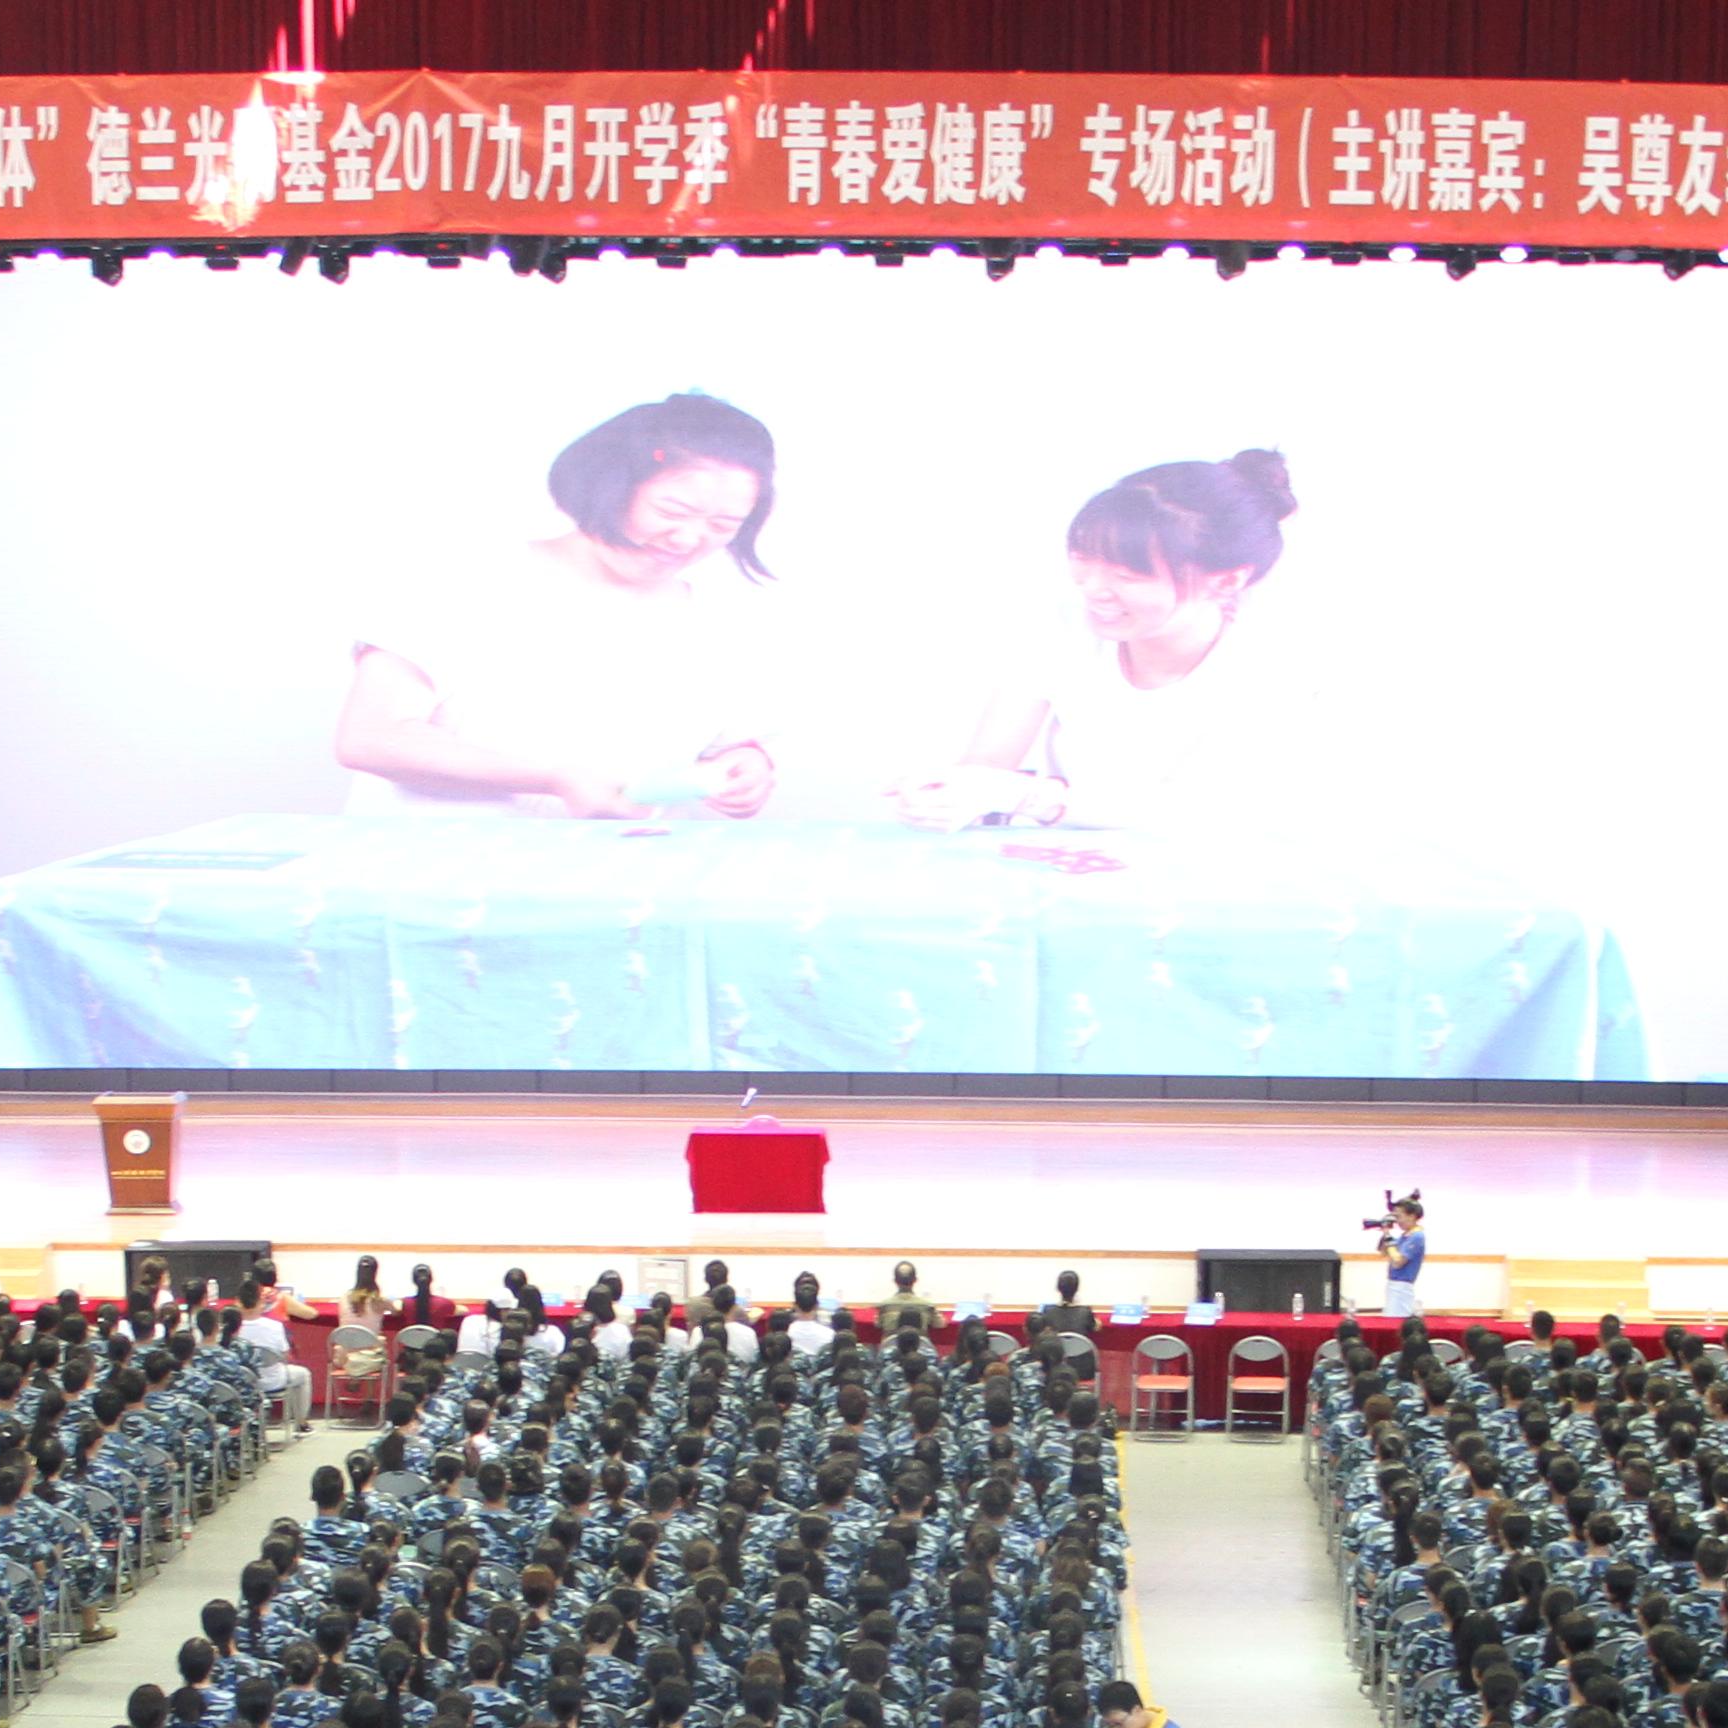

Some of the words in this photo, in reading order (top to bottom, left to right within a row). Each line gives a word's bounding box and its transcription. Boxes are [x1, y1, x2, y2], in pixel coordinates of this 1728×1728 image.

[86, 101, 728, 206] 德兰光基金2017九月开学季
[756, 100, 1053, 206] “青春爱健康”
